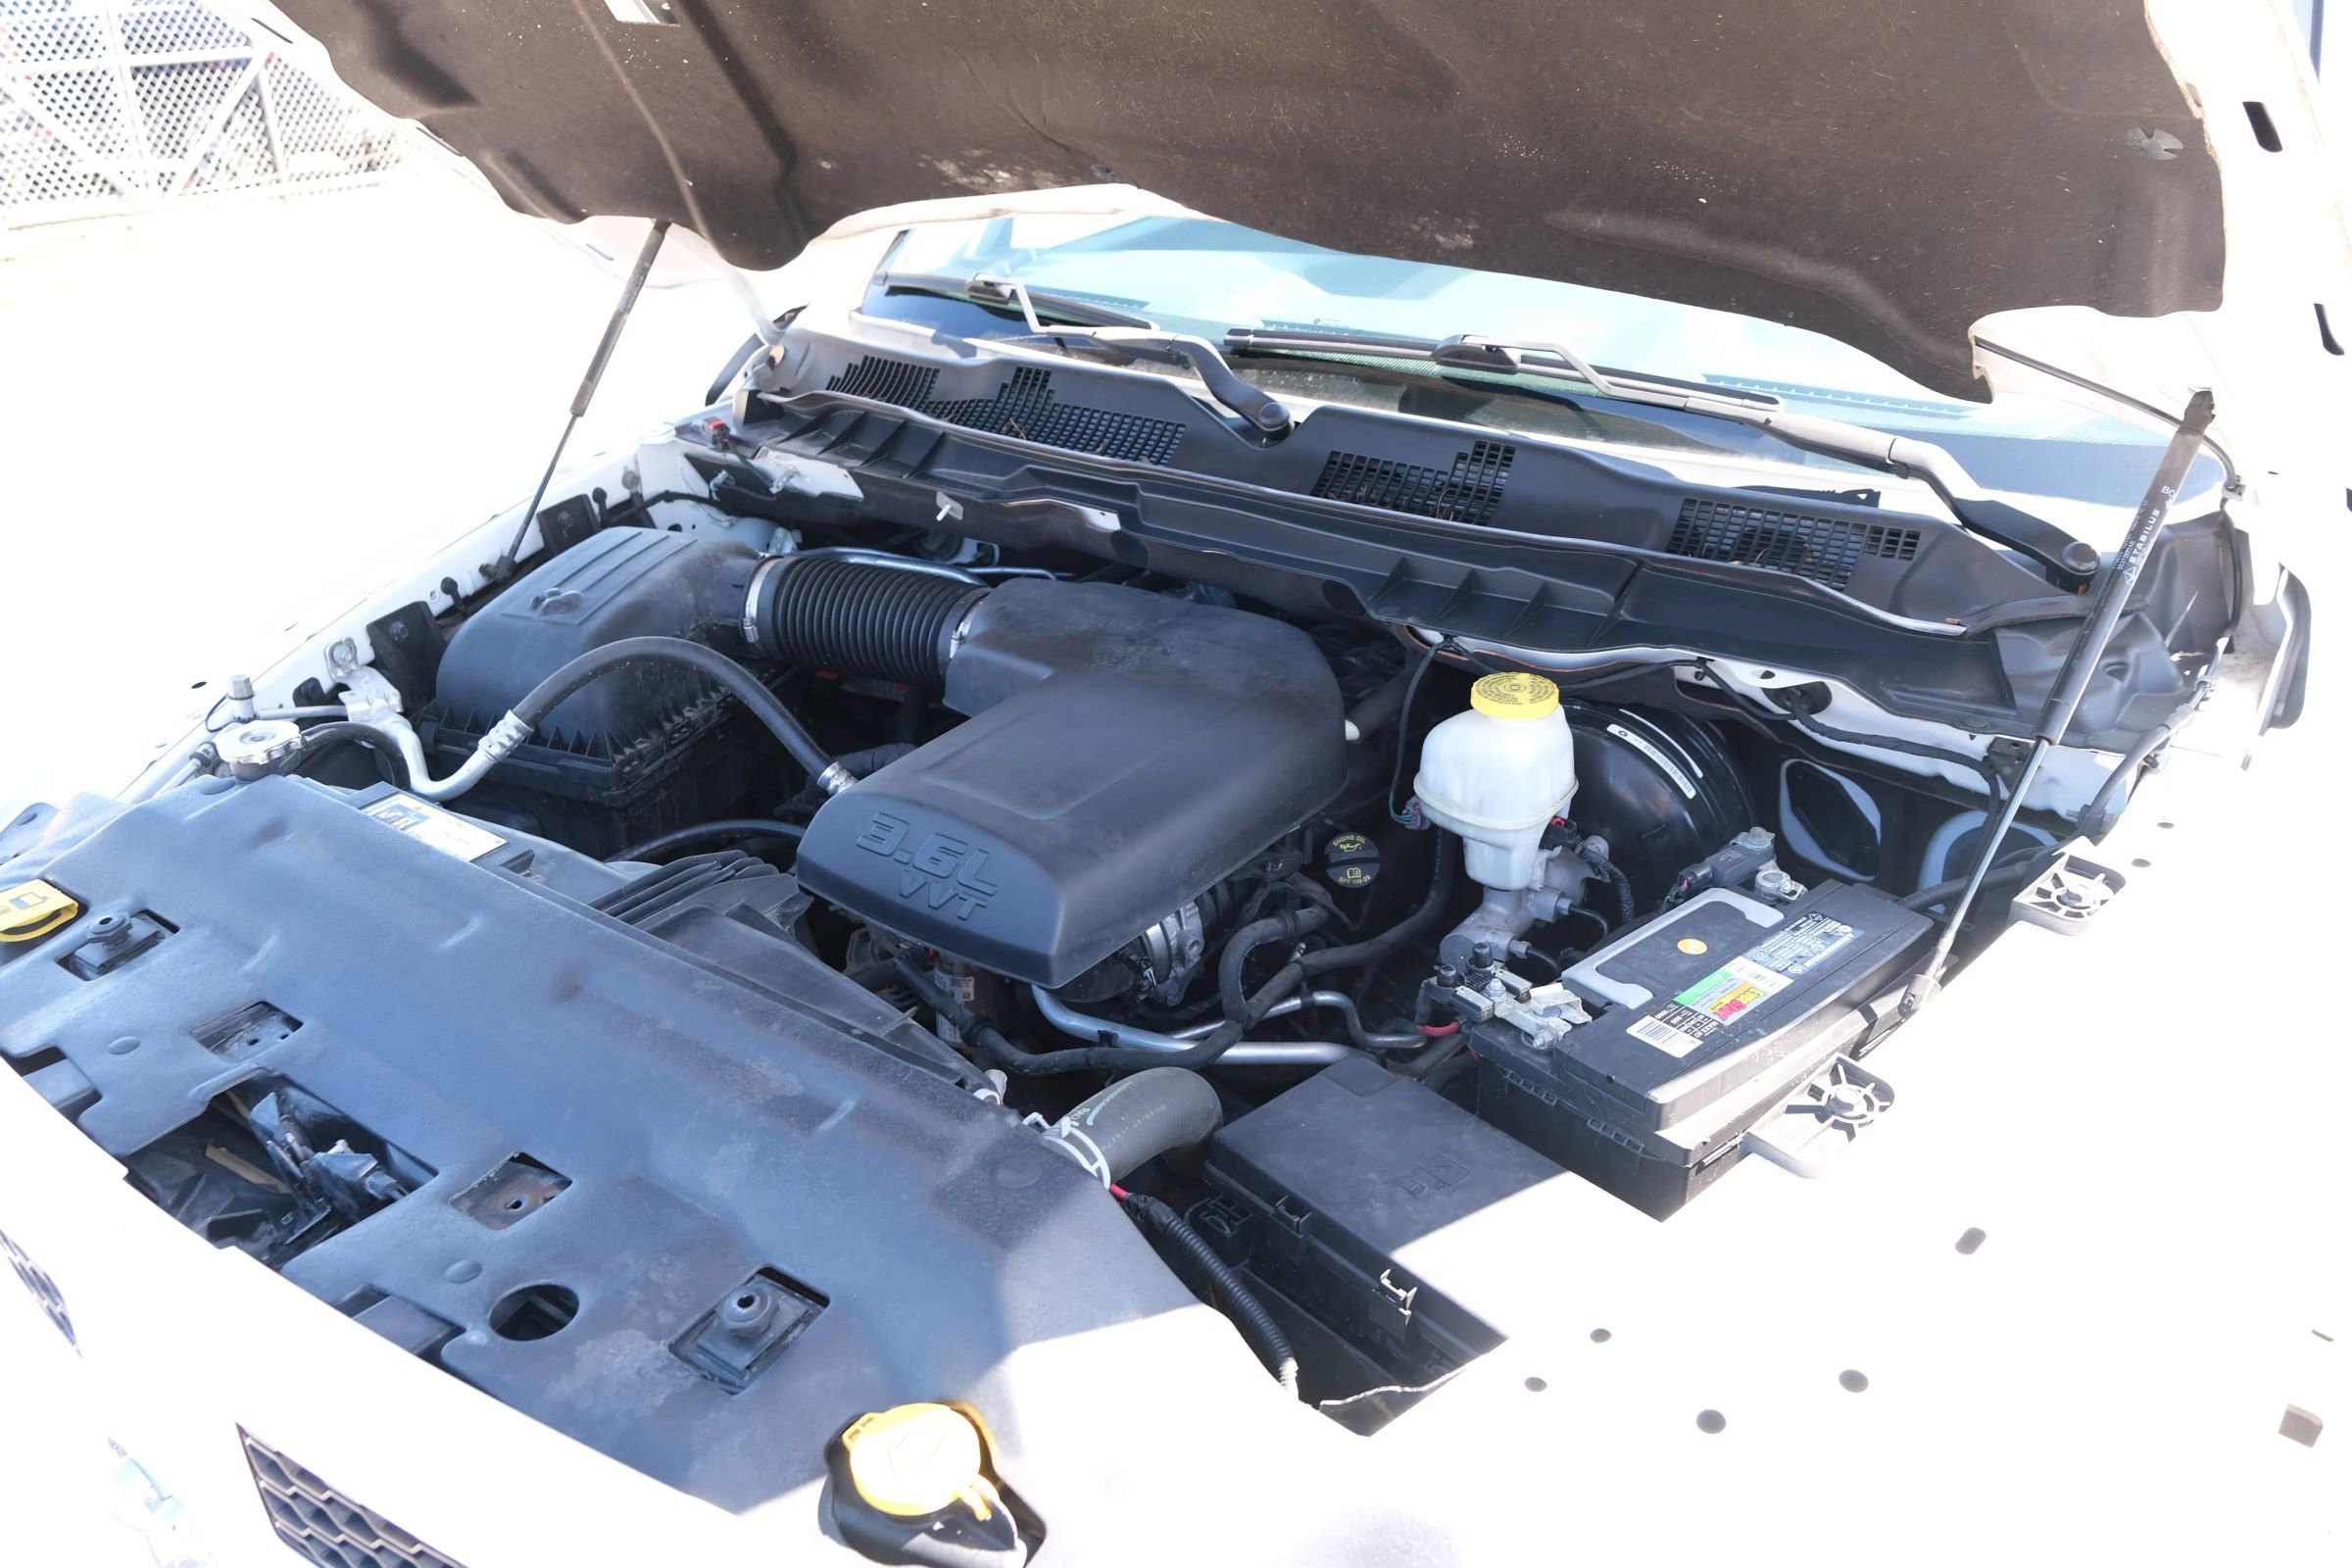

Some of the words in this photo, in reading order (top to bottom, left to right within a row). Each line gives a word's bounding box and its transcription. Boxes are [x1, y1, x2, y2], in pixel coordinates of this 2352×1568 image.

[2129, 509, 2161, 564] STABILUS
[856, 811, 998, 897] 3.6L
[1333, 835, 1354, 846] ENGINE
[1355, 835, 1366, 844] OIL
[899, 869, 988, 921] VVT
